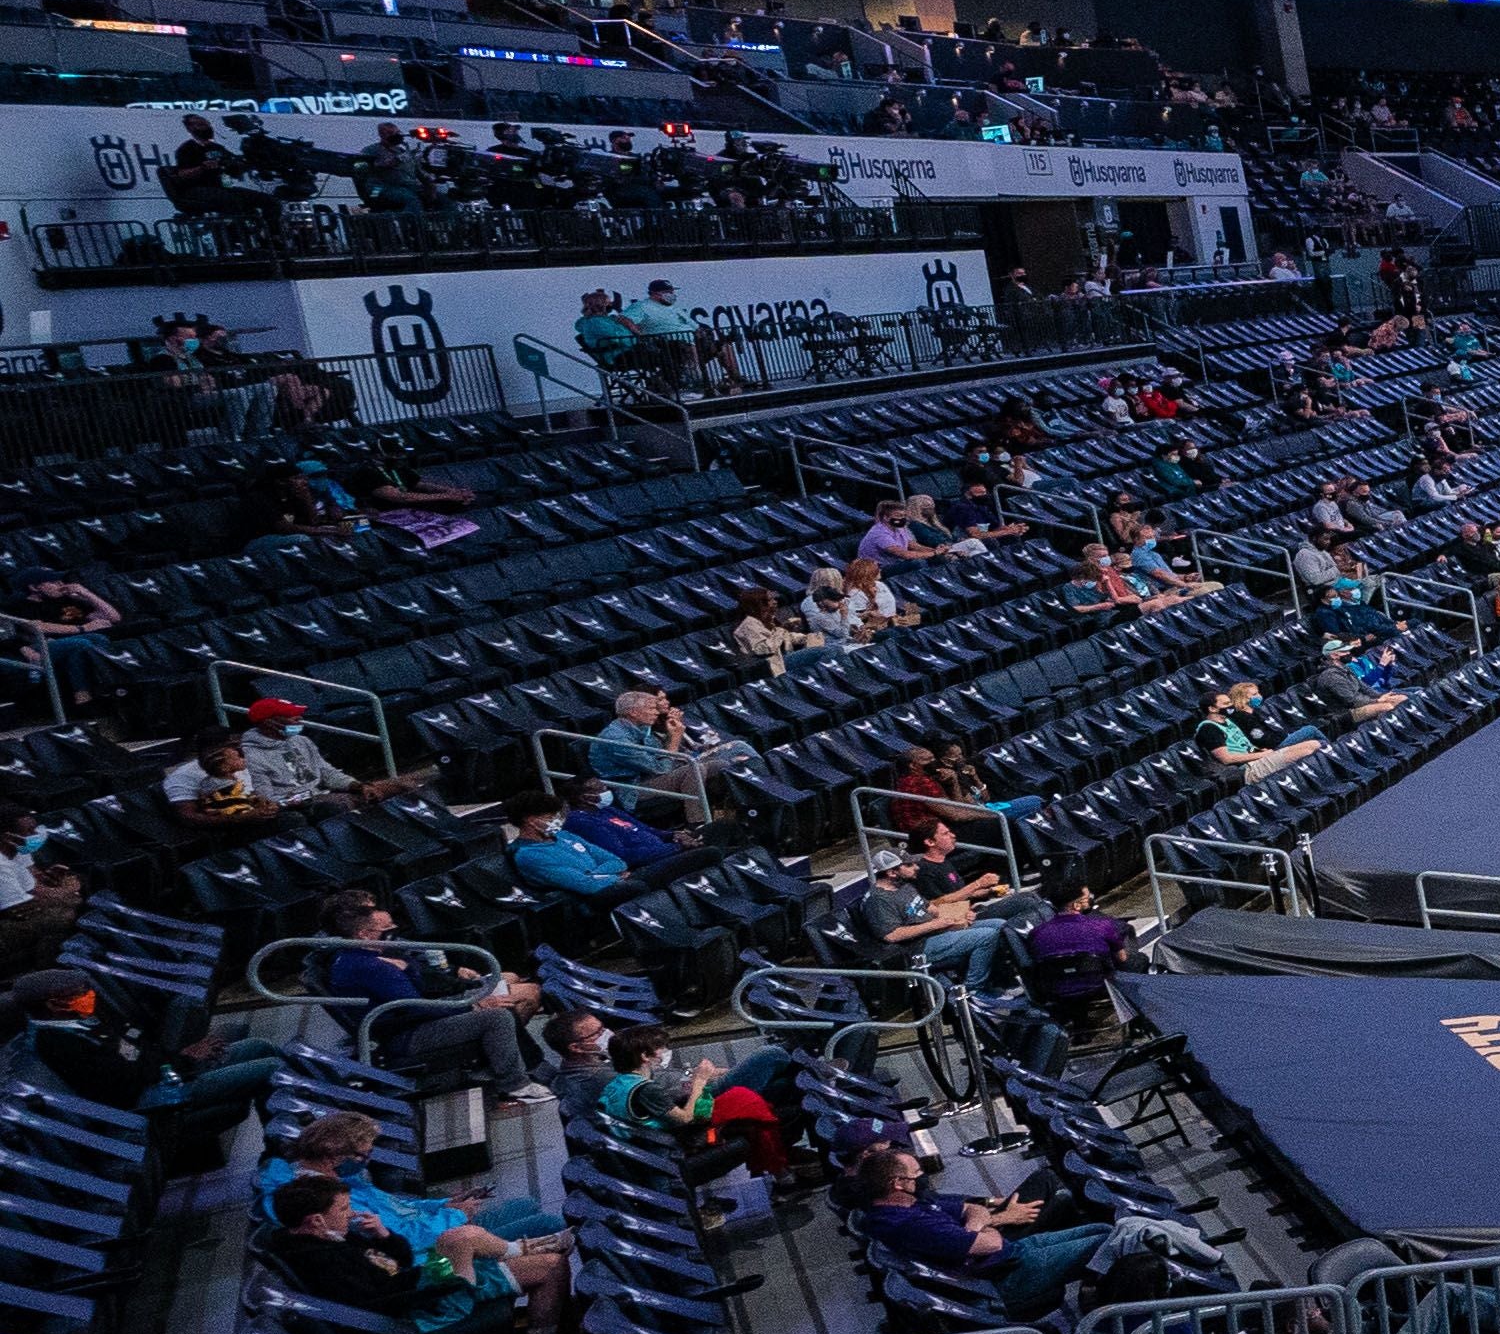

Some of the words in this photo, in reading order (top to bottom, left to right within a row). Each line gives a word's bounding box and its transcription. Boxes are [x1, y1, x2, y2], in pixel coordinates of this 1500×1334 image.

[848, 151, 936, 181] Husqvarna
[1028, 152, 1045, 171] 115
[1082, 160, 1146, 187] Husqvarna
[1186, 164, 1240, 187] Husqvarna
